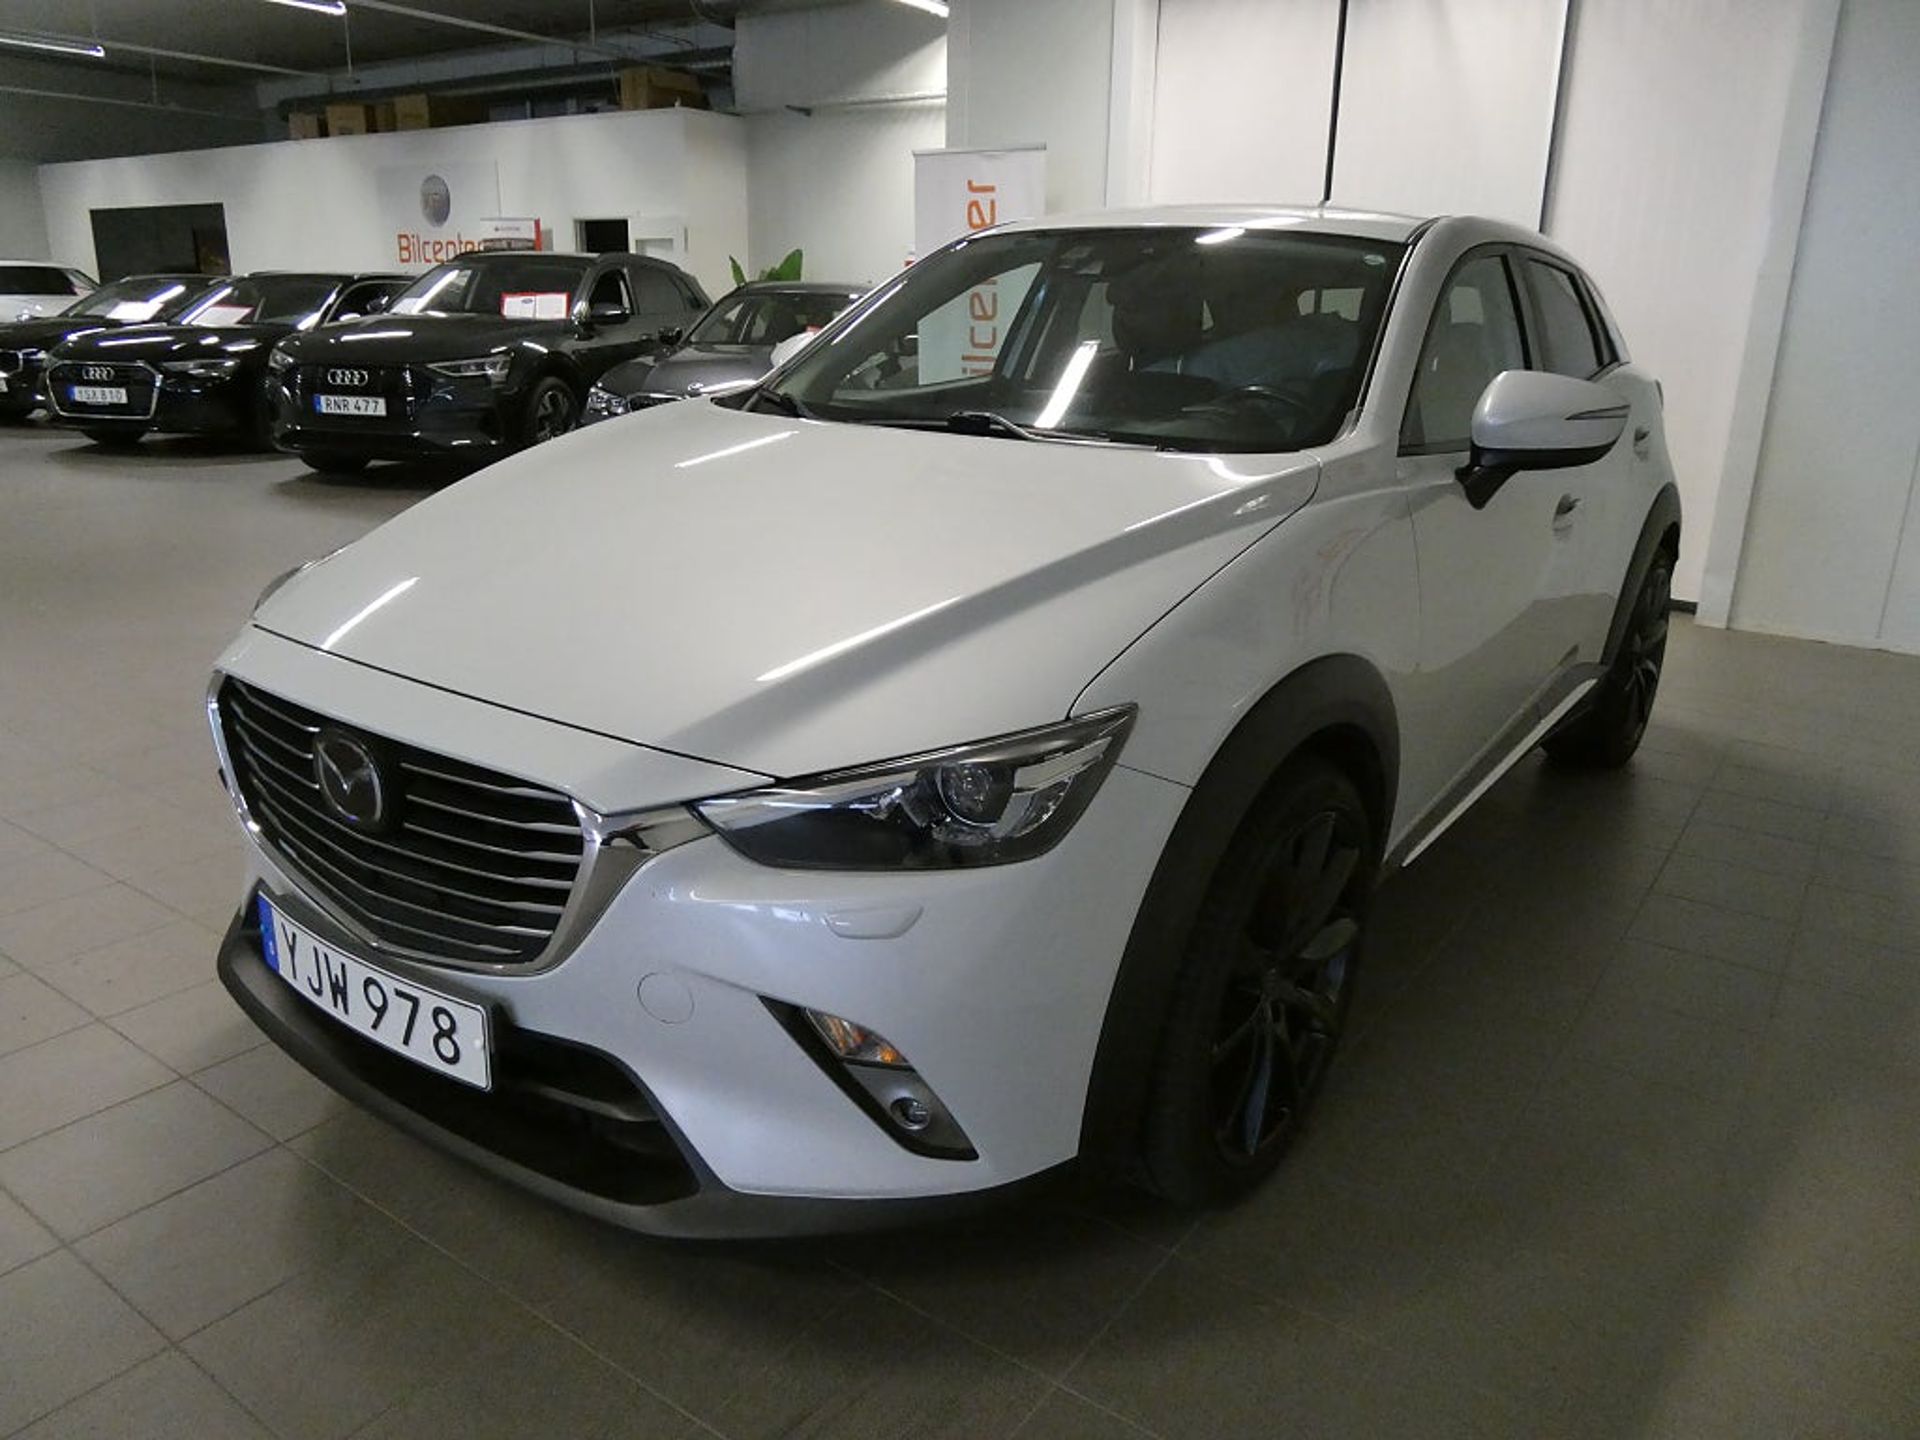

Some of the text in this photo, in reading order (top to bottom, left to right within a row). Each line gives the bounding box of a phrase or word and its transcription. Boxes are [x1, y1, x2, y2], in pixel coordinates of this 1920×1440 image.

[325, 397, 380, 413] RNR 477
[281, 921, 461, 1065] YJW 978
